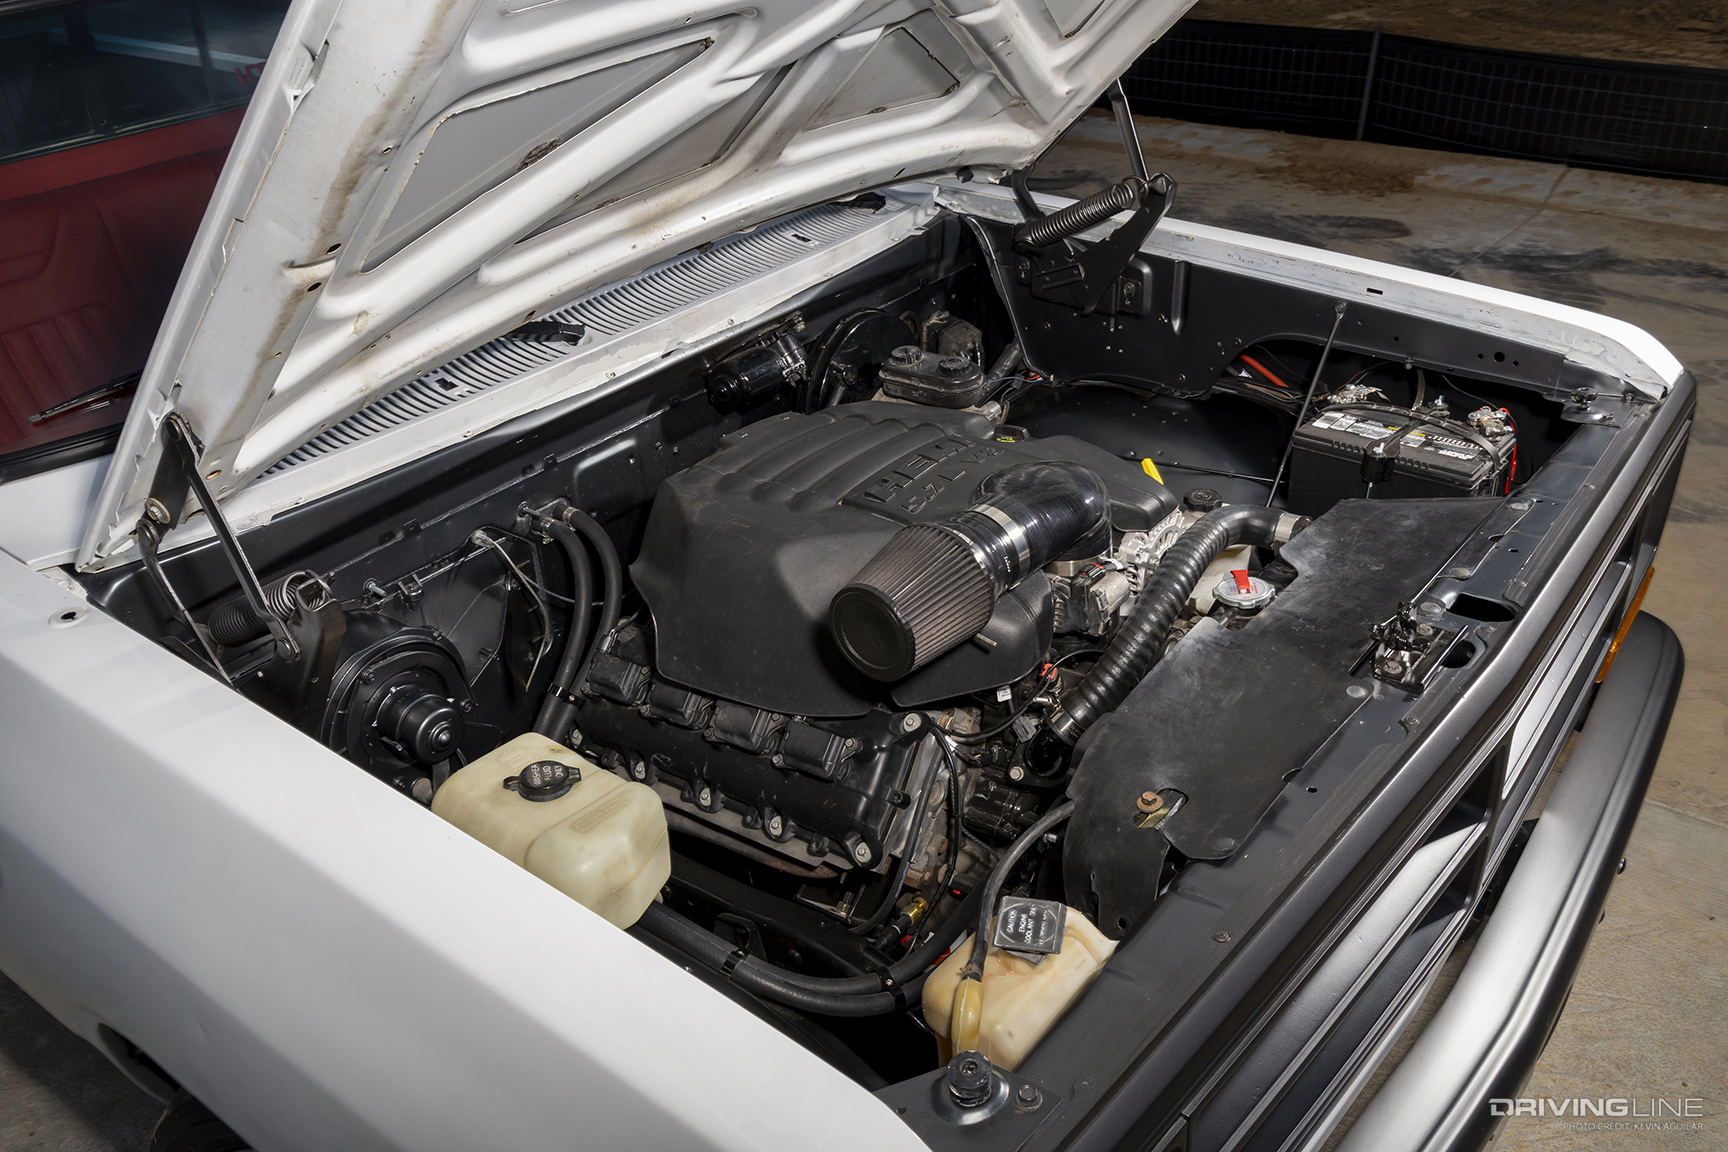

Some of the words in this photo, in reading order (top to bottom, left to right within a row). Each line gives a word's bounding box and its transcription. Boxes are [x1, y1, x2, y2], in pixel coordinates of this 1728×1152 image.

[863, 438, 976, 504] HEMI
[530, 763, 542, 786] WASHER
[542, 765, 552, 781] FLUID
[554, 764, 564, 778] ONLY
[1006, 909, 1017, 933] CAUTION
[1018, 913, 1028, 933] ENGINE
[1024, 918, 1034, 944] COOLANT
